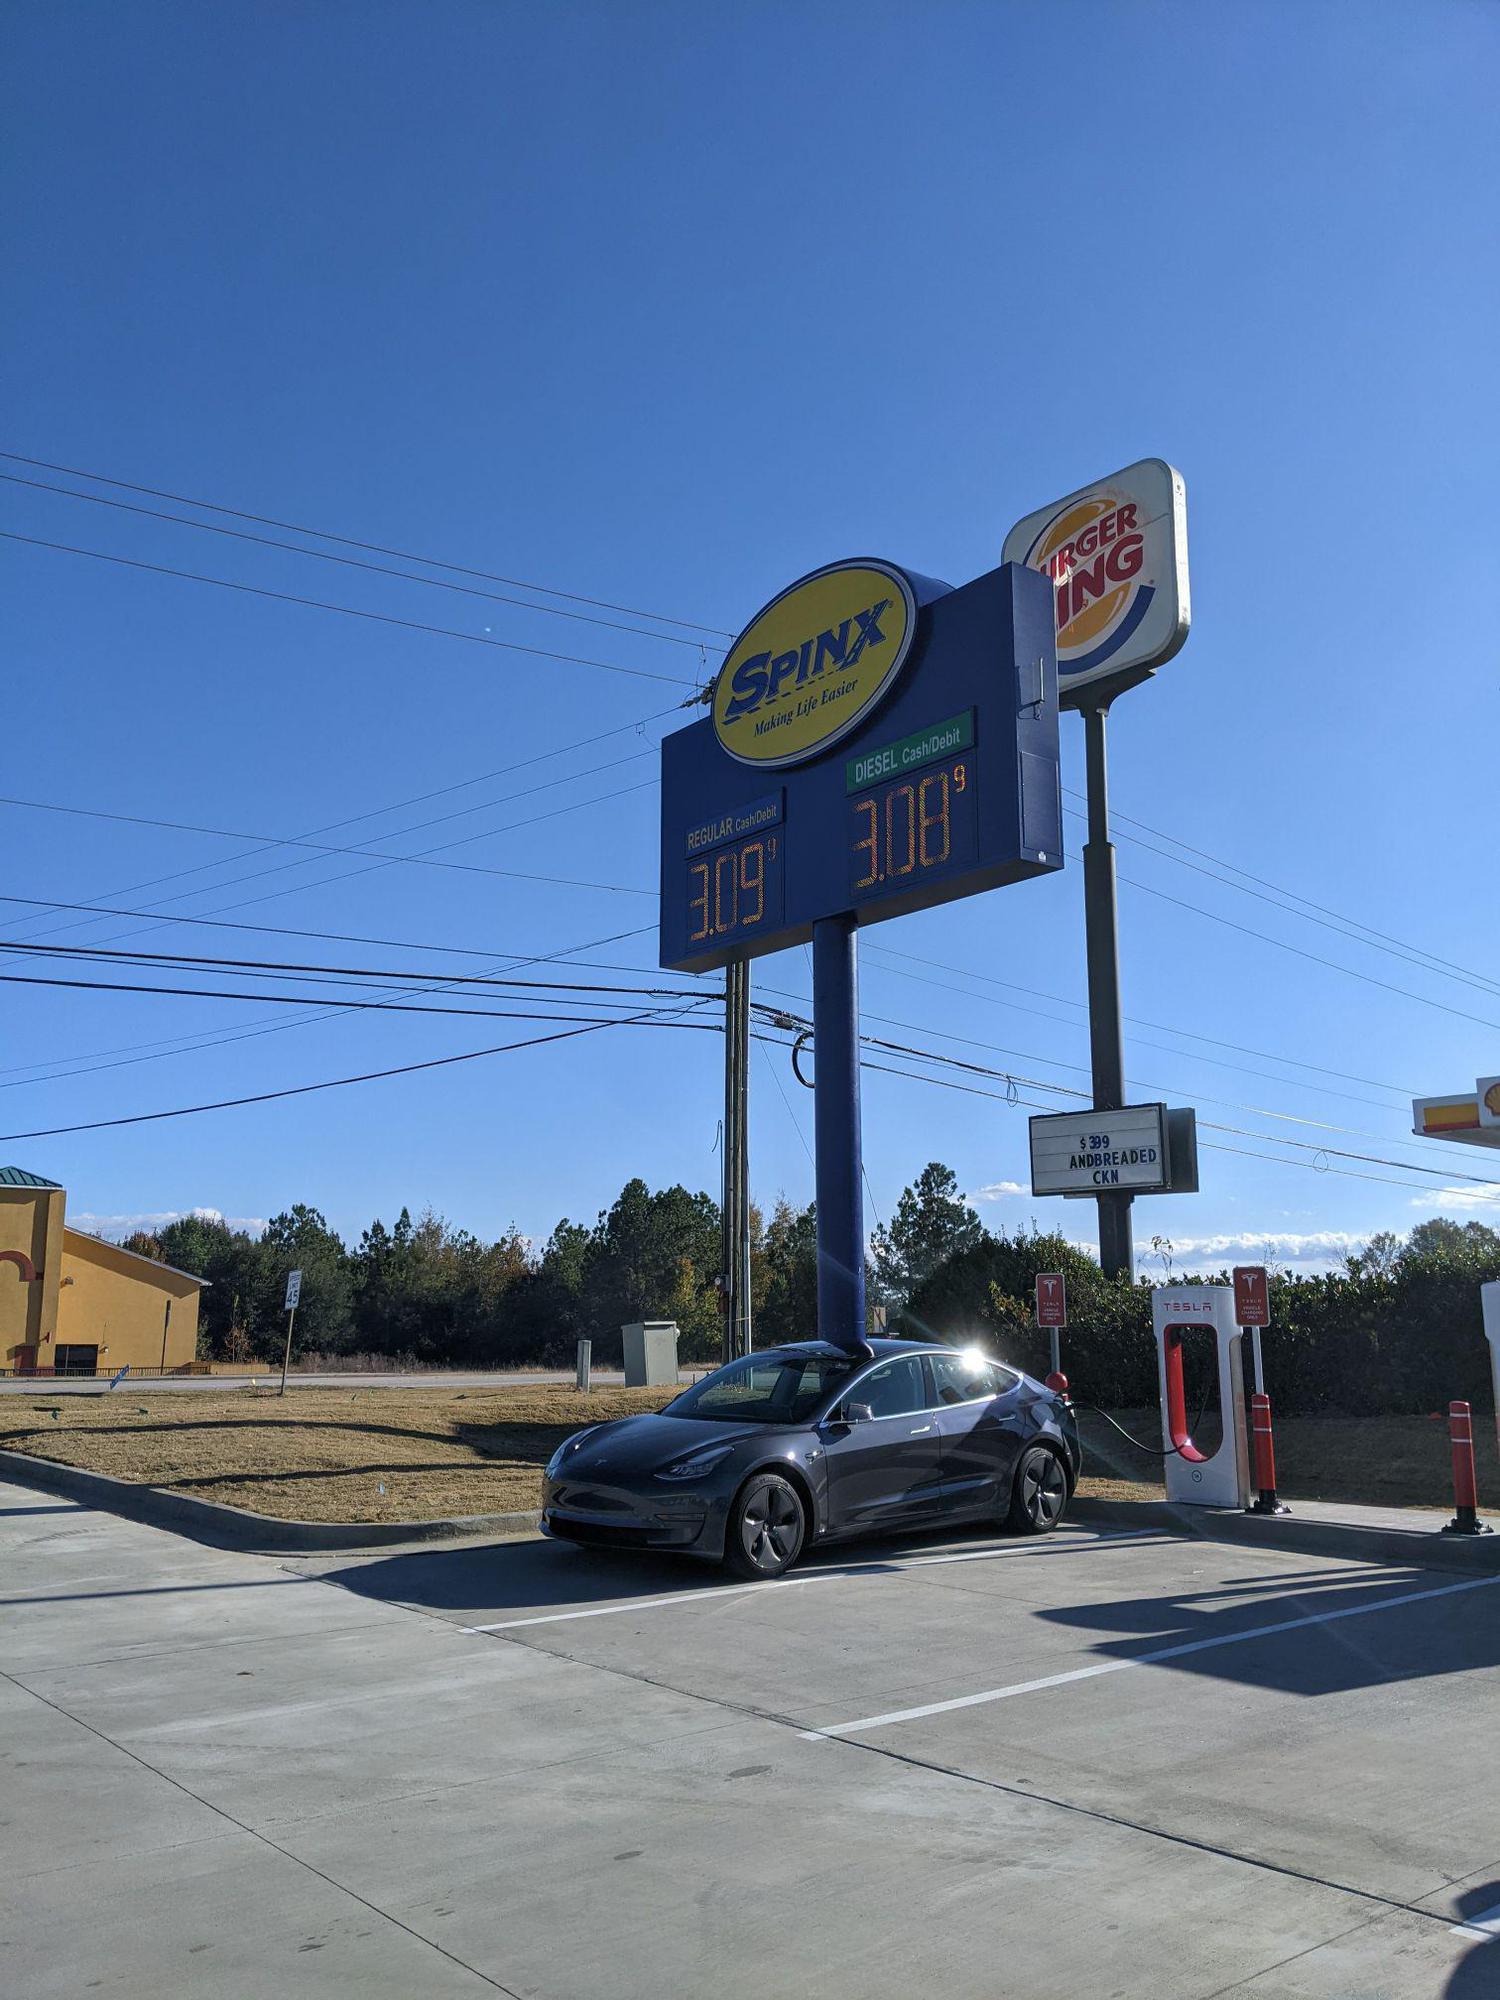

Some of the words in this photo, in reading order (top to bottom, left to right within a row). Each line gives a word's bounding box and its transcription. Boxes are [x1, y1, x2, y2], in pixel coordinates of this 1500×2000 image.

[1040, 503, 1137, 580] URGER
[1057, 534, 1143, 629] ING
[725, 599, 888, 717] SPINX
[754, 709, 793, 737] Making
[796, 695, 818, 717] Life
[821, 679, 858, 705] Easier
[855, 749, 898, 783] DIESEL
[902, 727, 961, 764] Cash/Debit
[688, 817, 733, 849] REGULAR
[735, 804, 777, 832] Cash/Debit
[1093, 1169, 1119, 1185] CKN
[287, 1290, 298, 1305] 45
[1163, 1302, 1212, 1311] TESLA
